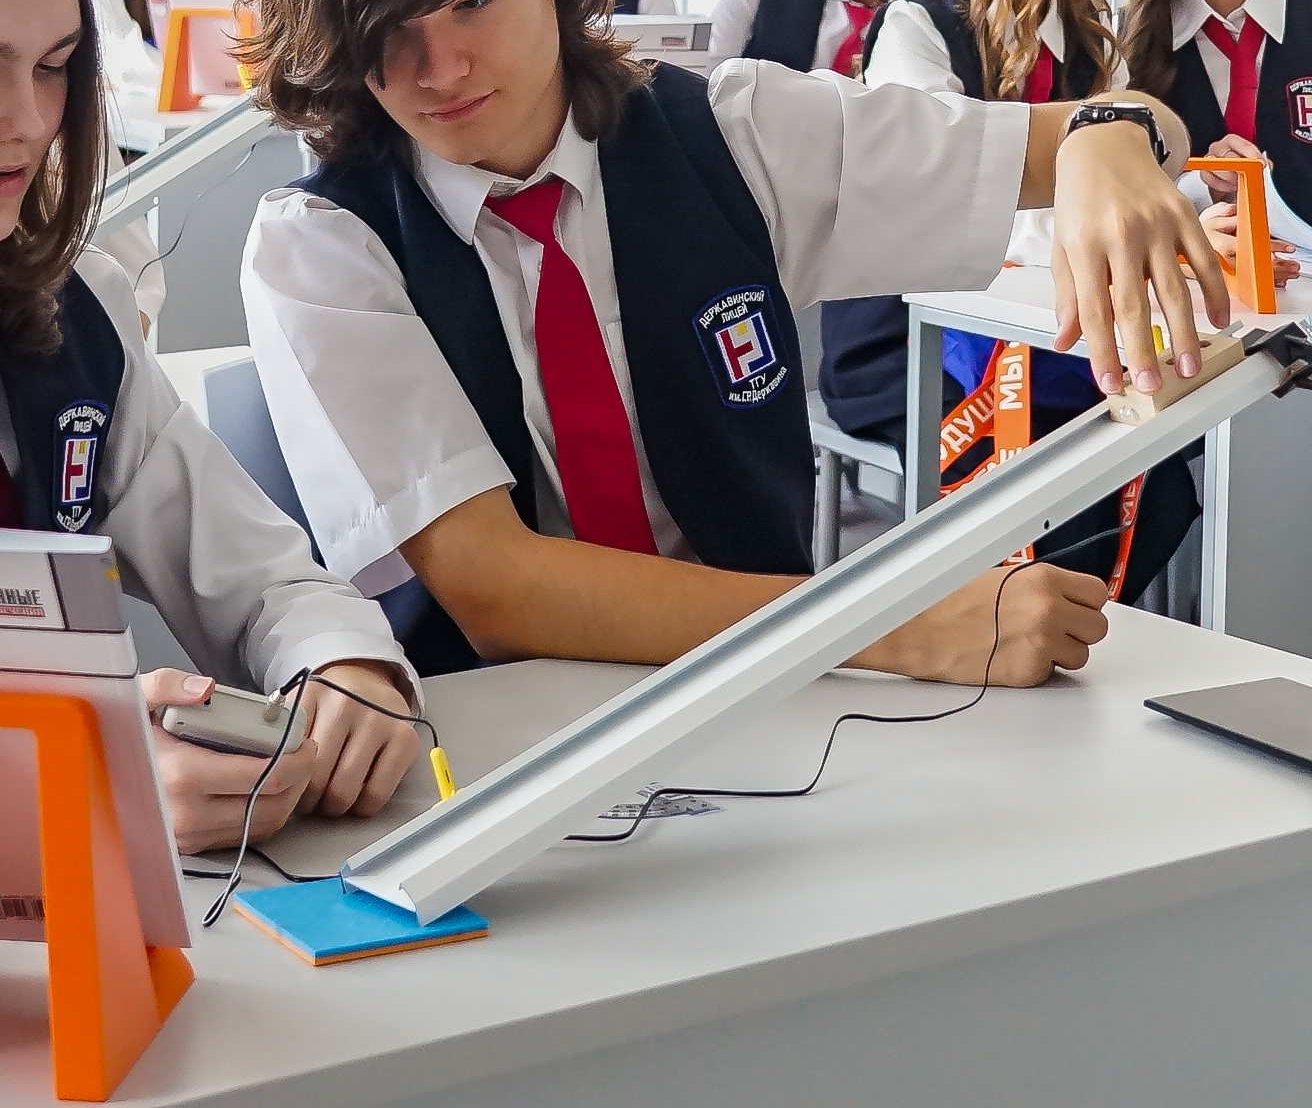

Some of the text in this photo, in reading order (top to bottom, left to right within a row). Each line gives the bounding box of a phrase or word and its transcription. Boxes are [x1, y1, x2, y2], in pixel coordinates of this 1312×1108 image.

[699, 290, 765, 329] ДЕРЖАВИНСКИЙ
[721, 303, 748, 323] ЛИЦЕЙ
[749, 373, 766, 389] ТГУ
[999, 354, 1024, 412] МЫ
